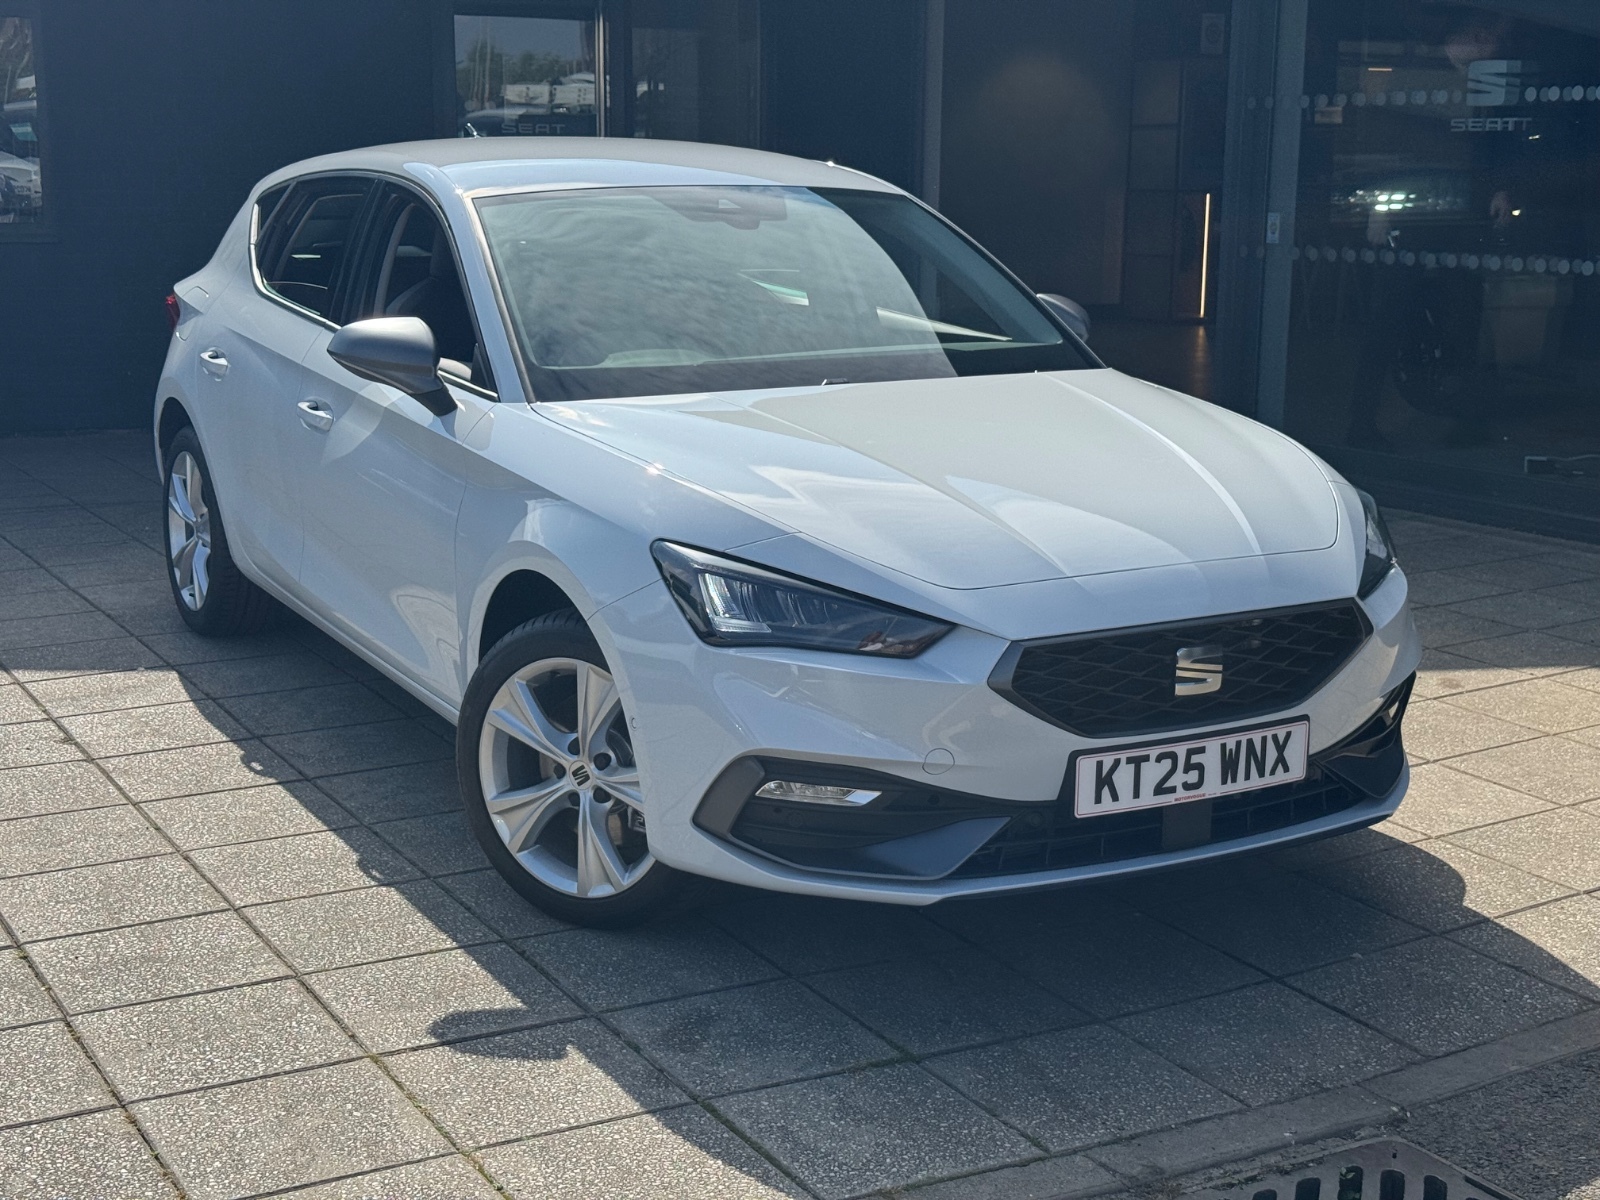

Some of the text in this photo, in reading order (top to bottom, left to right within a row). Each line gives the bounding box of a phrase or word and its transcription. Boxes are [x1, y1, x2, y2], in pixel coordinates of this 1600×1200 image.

[502, 123, 565, 134] SEAT
[1094, 731, 1292, 805] KT25 WNX
